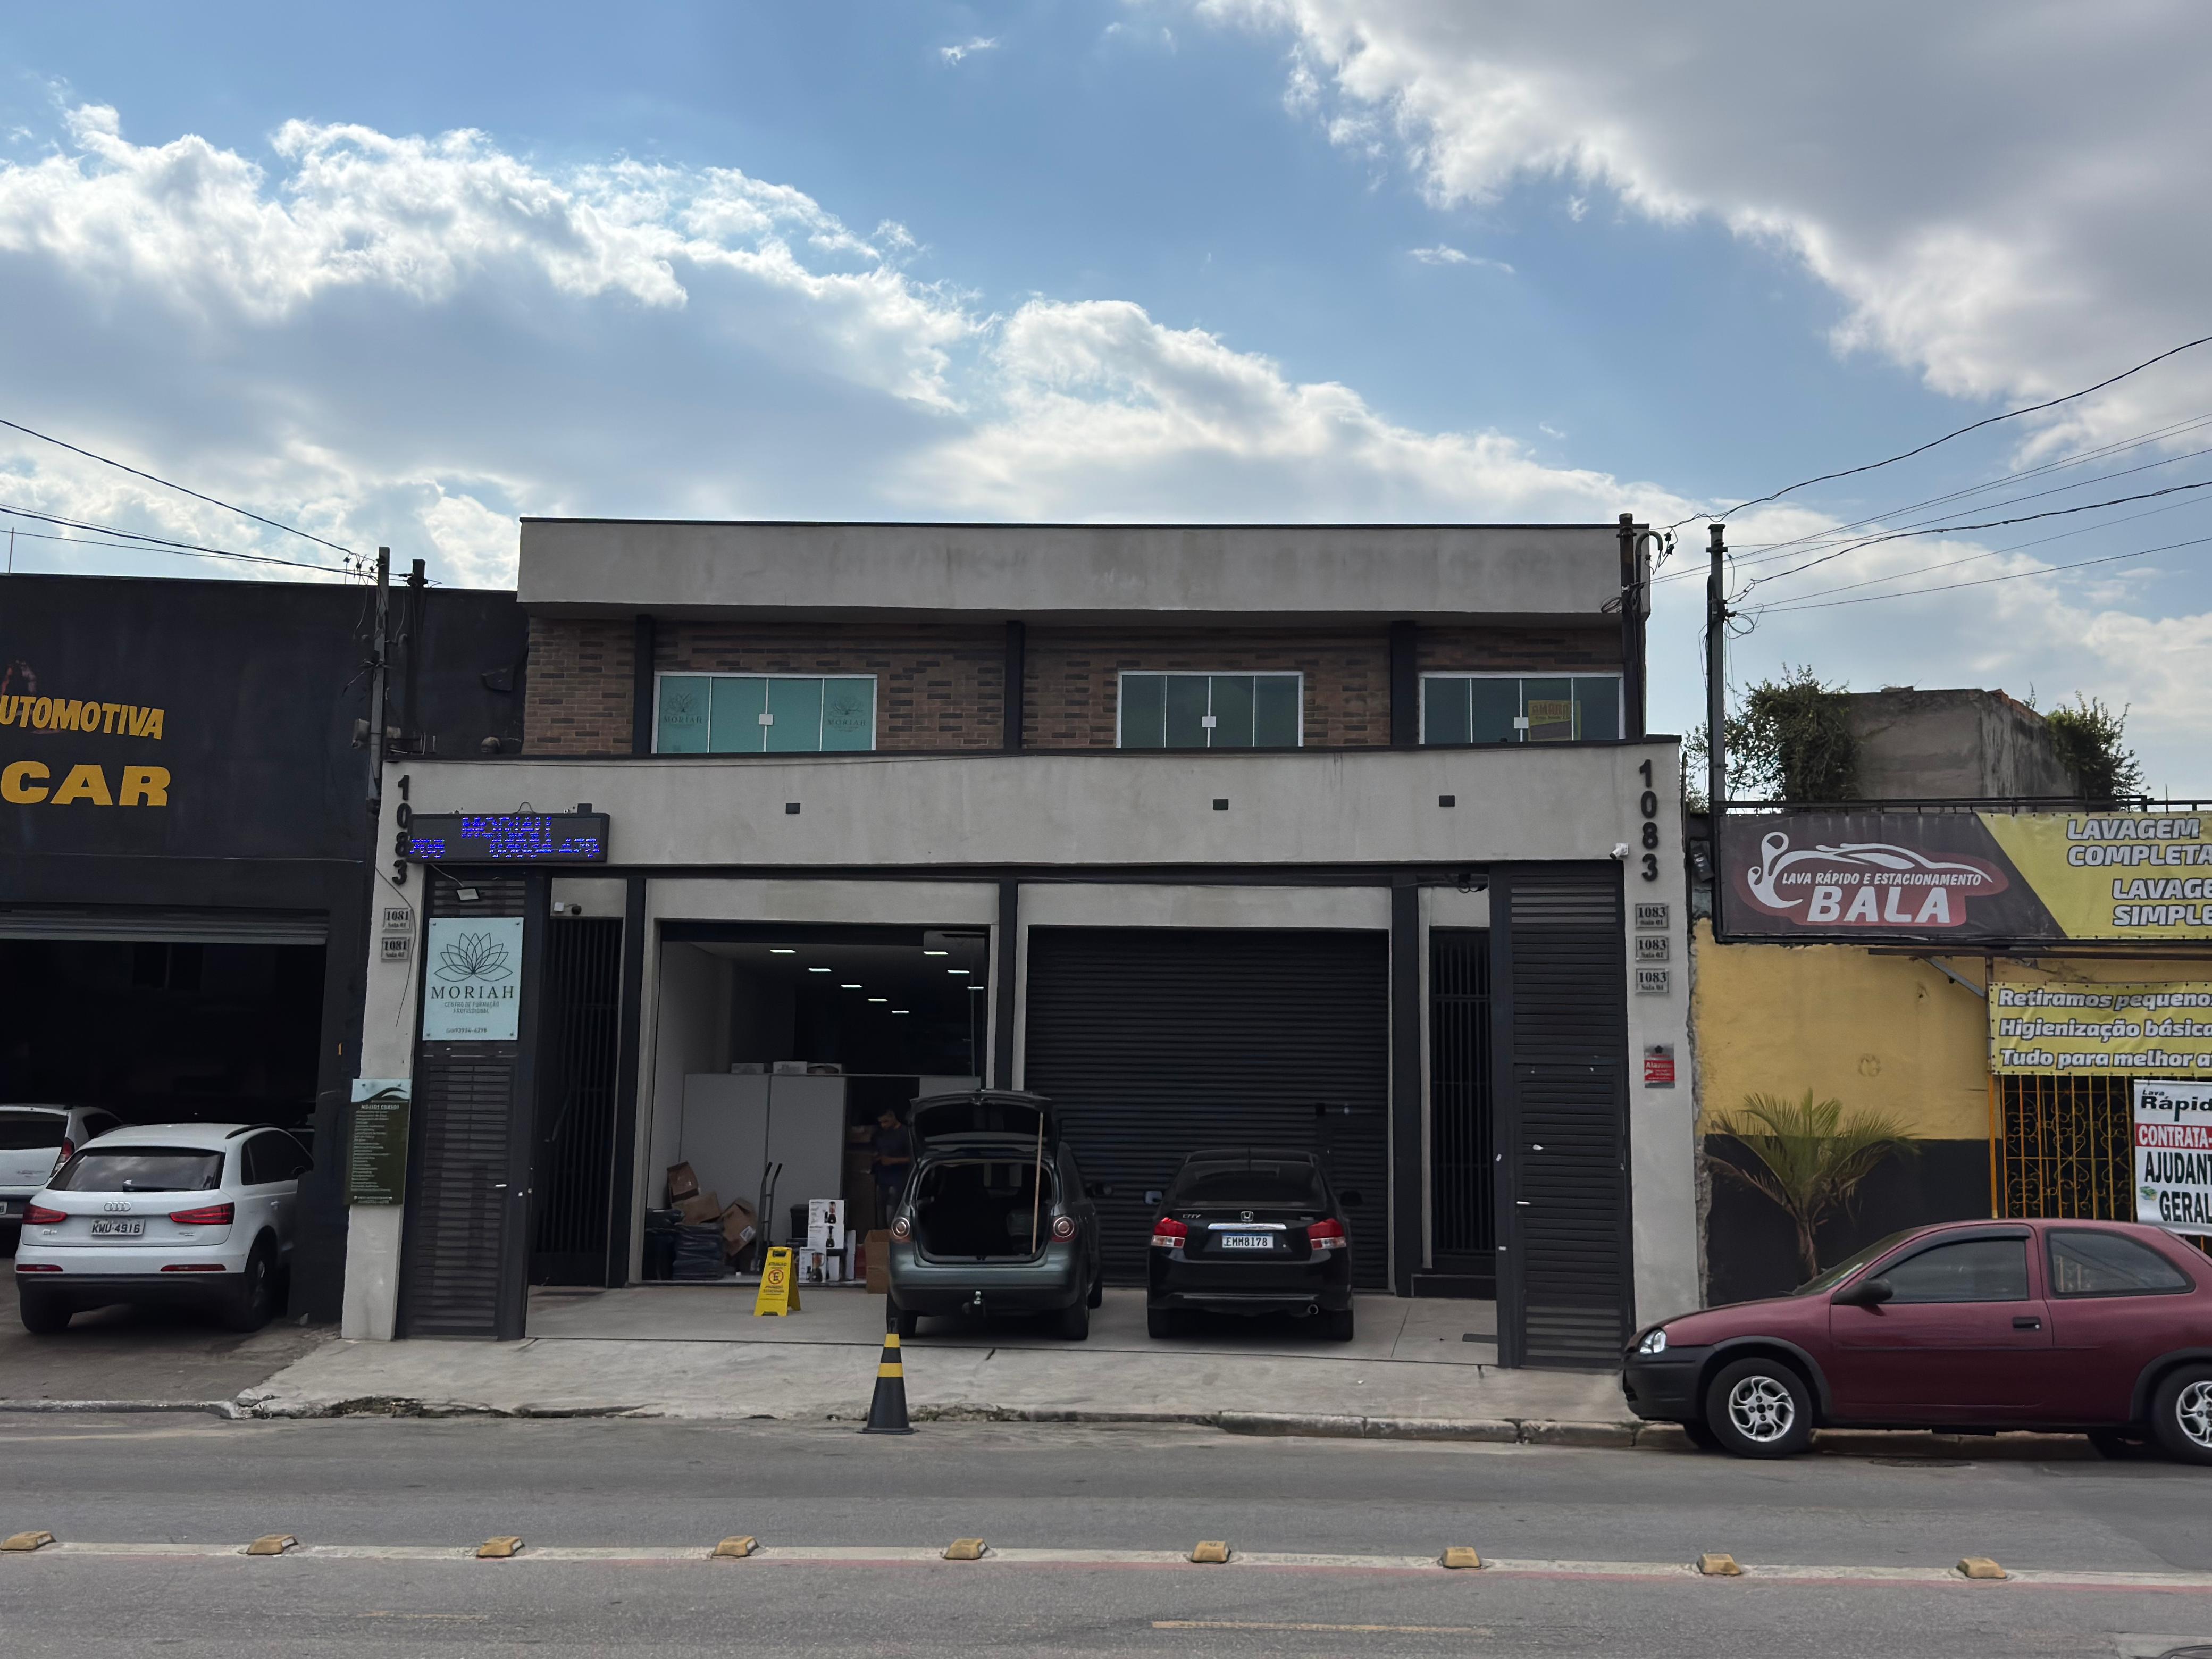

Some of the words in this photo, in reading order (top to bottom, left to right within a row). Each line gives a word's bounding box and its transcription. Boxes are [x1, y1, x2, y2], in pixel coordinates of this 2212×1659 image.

[0, 761, 171, 806] CAR
[1639, 759, 1658, 882] 1083
[2066, 818, 2200, 840] LAVAGEM
[2067, 844, 2212, 867] COMPLETA
[1782, 872, 1811, 885] LAVA
[1815, 870, 1860, 885] RÁPIDO
[1863, 873, 1872, 885] E
[1873, 873, 1982, 886] ESTACIONAMENTO
[1638, 907, 1666, 918] 1083
[1807, 885, 1950, 923] BALA
[387, 911, 409, 921] 1081
[384, 940, 407, 951] 1081
[1638, 939, 1667, 950] 1083
[1639, 971, 1667, 983] 1083
[431, 986, 515, 999] MORIAH
[1998, 987, 2113, 1009] Retiramos
[2113, 992, 2212, 1012] pequeno
[1999, 1017, 2141, 1042] Higienização
[2000, 1048, 2055, 1068] Tudo
[2056, 1052, 2110, 1070] para
[2112, 1049, 2196, 1068] melhor
[2196, 1053, 2212, 1068] a
[2159, 1190, 2212, 1224] GERAL
